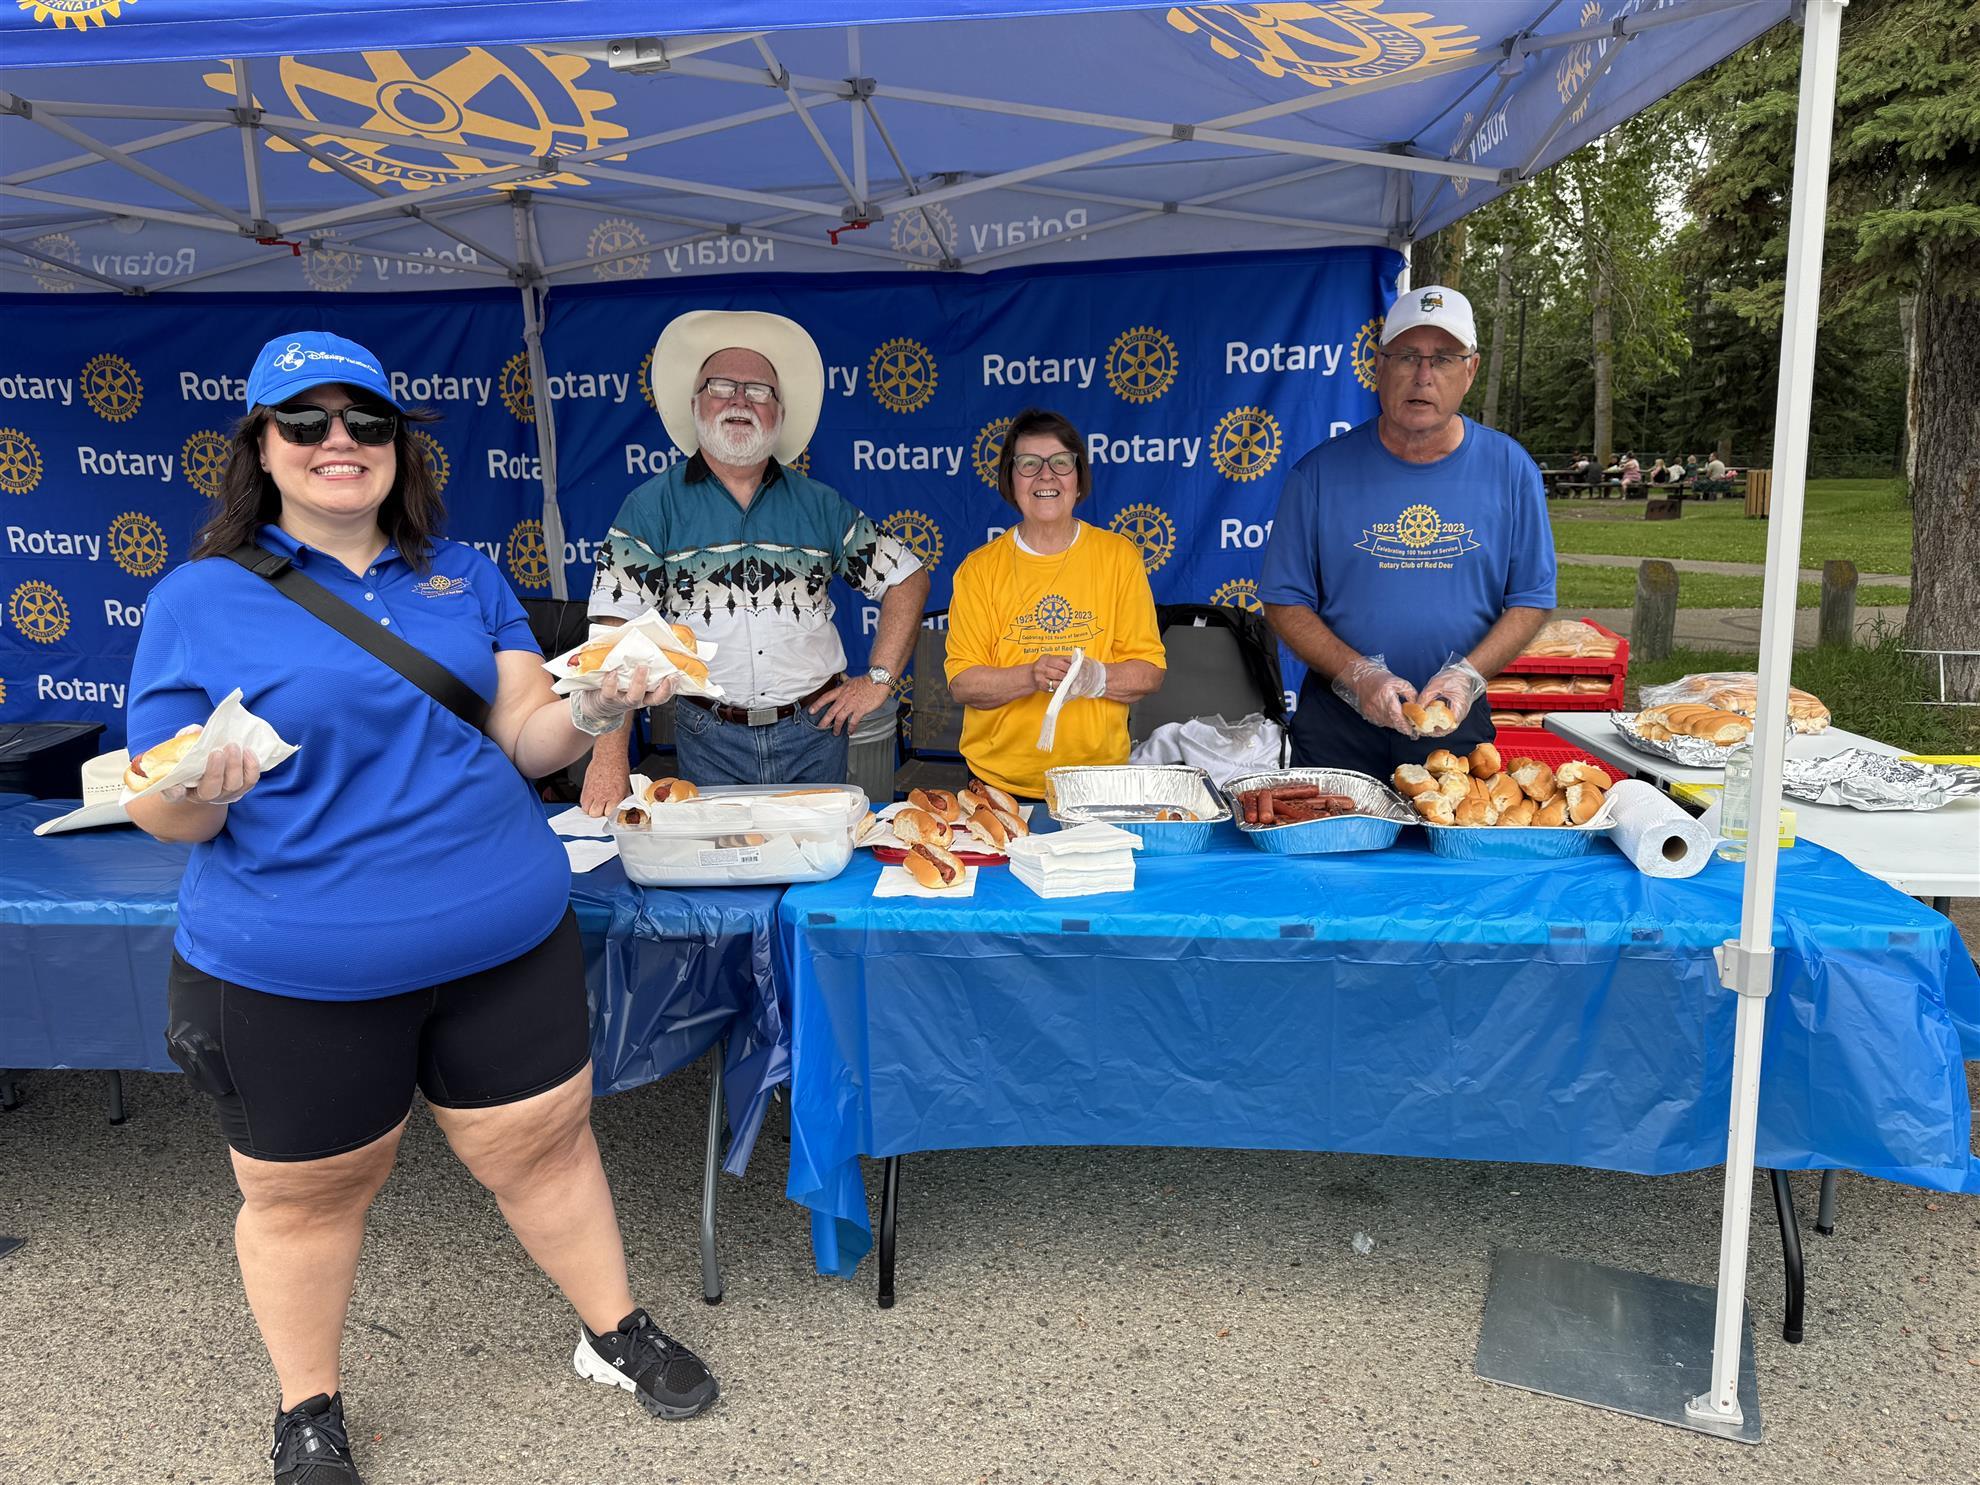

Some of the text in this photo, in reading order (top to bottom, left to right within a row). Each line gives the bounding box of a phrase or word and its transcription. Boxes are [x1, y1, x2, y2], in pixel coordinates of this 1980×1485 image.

[887, 345, 916, 355] ROTARY
[1127, 335, 1157, 345] ROTARY
[983, 354, 1096, 389] Rotary
[1225, 341, 1343, 376] Rotary
[0, 373, 72, 406] otary
[180, 372, 247, 401] Rota
[390, 372, 491, 406] Rotary
[546, 371, 629, 403] otary
[1231, 414, 1262, 424] ROTARY
[0, 434, 21, 443] OTARY
[1087, 433, 1201, 467] Rotary
[78, 446, 173, 482] Rotary
[487, 449, 542, 480] Rota
[625, 444, 682, 475] Rot
[853, 440, 963, 476] Rotary
[1220, 455, 1270, 474] INTERNATIONAL
[1126, 511, 1155, 520] ROTARY
[1372, 522, 1465, 533] 1923 2023
[7, 526, 100, 561] Rotary
[1220, 518, 1274, 549] Rot
[1376, 545, 1405, 556] Celebrating
[1439, 546, 1458, 554] Service
[1379, 561, 1453, 570] Rotary Club of Red Deer
[1226, 587, 1257, 595] ROTARY
[1016, 611, 1092, 624] 1923 2023
[38, 674, 126, 708] Rotary
